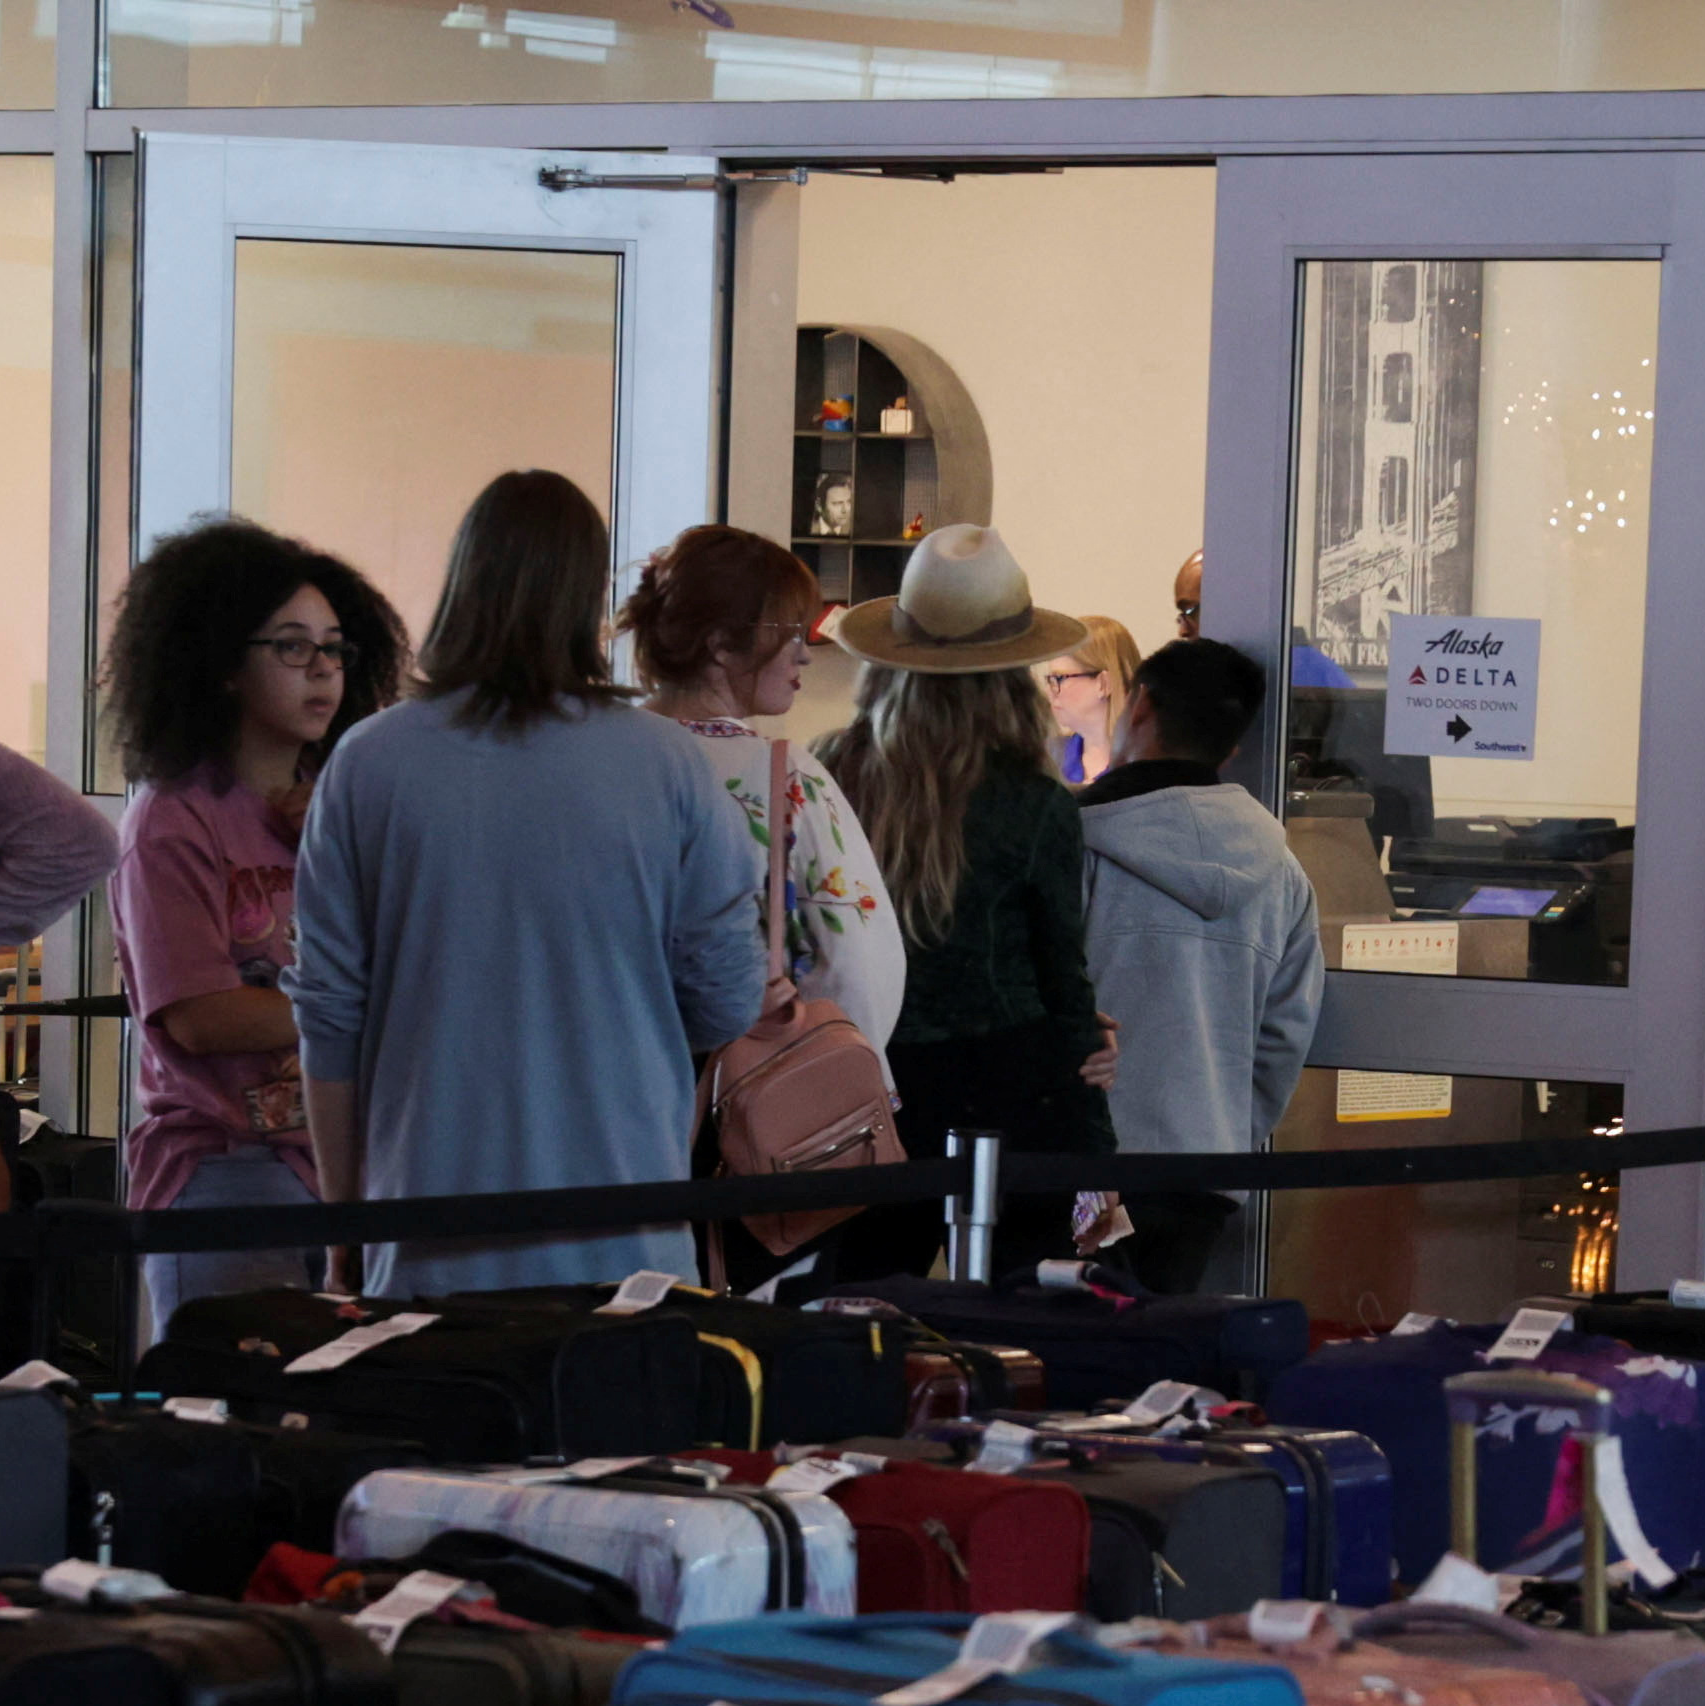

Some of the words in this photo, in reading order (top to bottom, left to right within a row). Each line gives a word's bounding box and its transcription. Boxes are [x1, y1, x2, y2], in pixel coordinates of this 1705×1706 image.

[1425, 628, 1504, 659] Alaska
[1436, 667, 1517, 687] DELTA
[1406, 697, 1433, 709] TWO
[1436, 698, 1477, 711] DOORS
[1480, 700, 1518, 712] DOWN
[1474, 741, 1521, 752] Southwest
